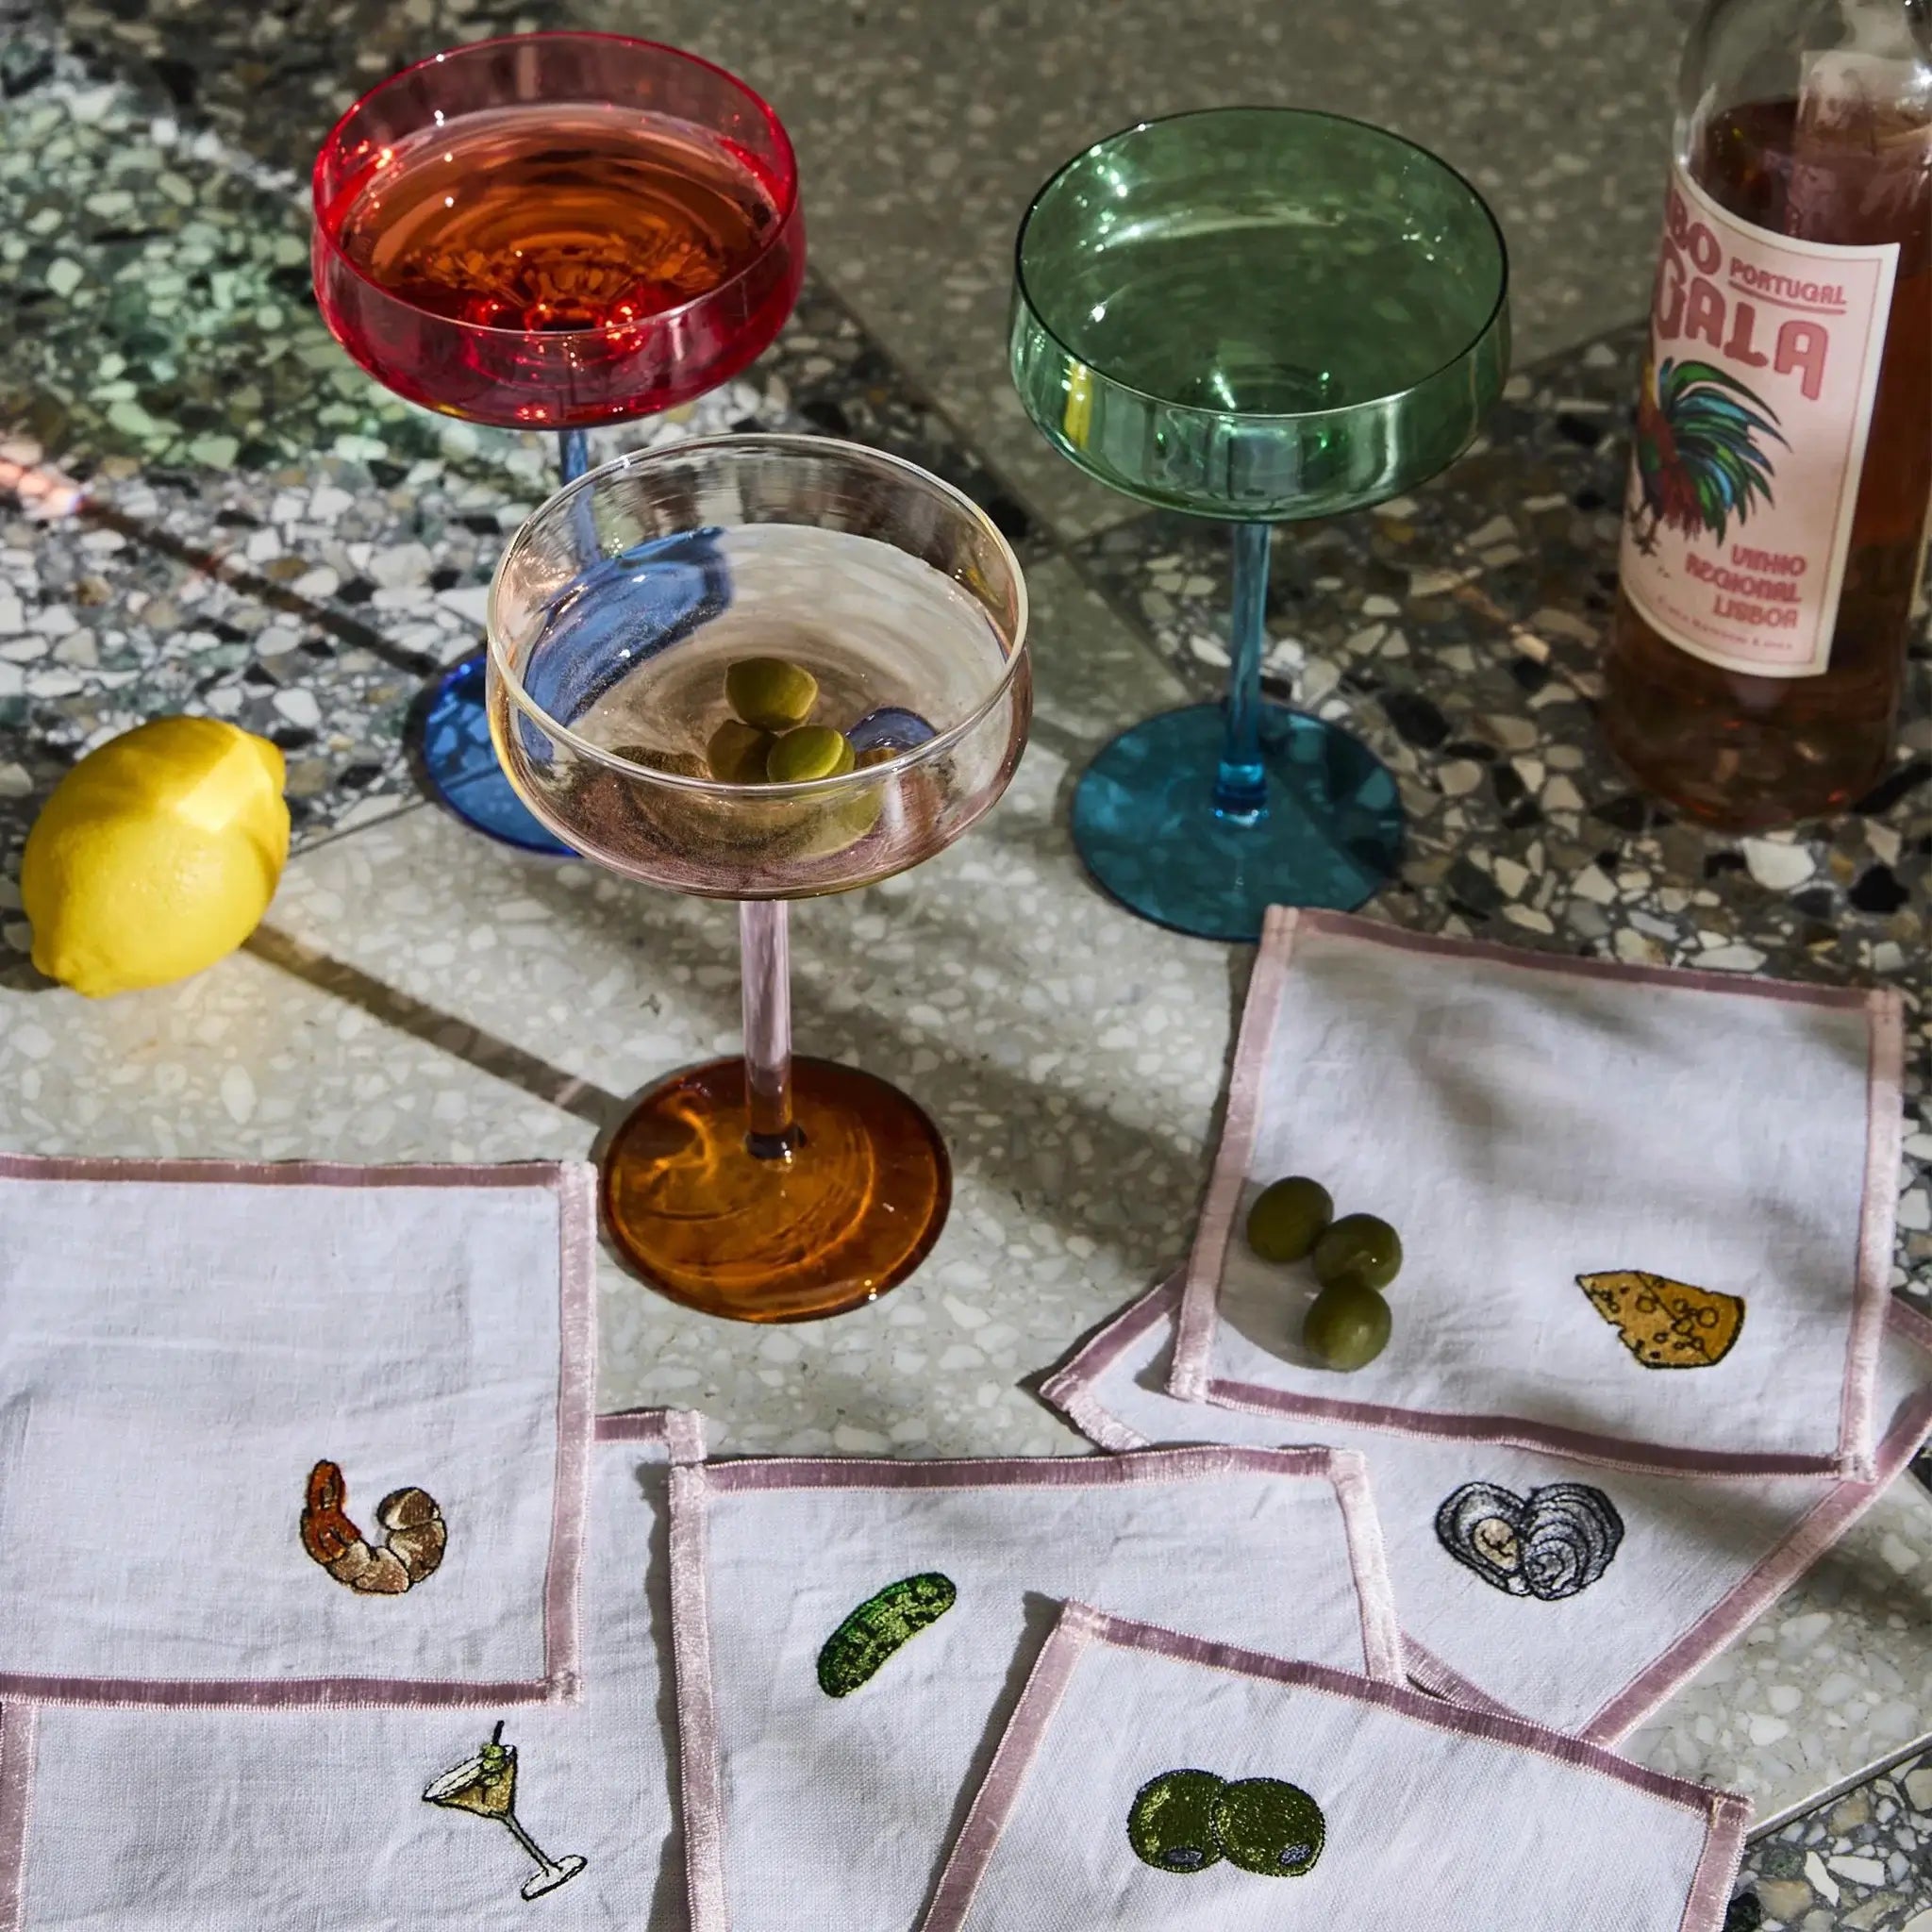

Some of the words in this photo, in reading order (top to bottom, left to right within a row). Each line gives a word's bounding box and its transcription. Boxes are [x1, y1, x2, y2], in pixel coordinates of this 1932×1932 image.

[1666, 189, 1722, 275] BO
[1655, 236, 1828, 401] GALA
[1730, 257, 1846, 306] PORTUGAL
